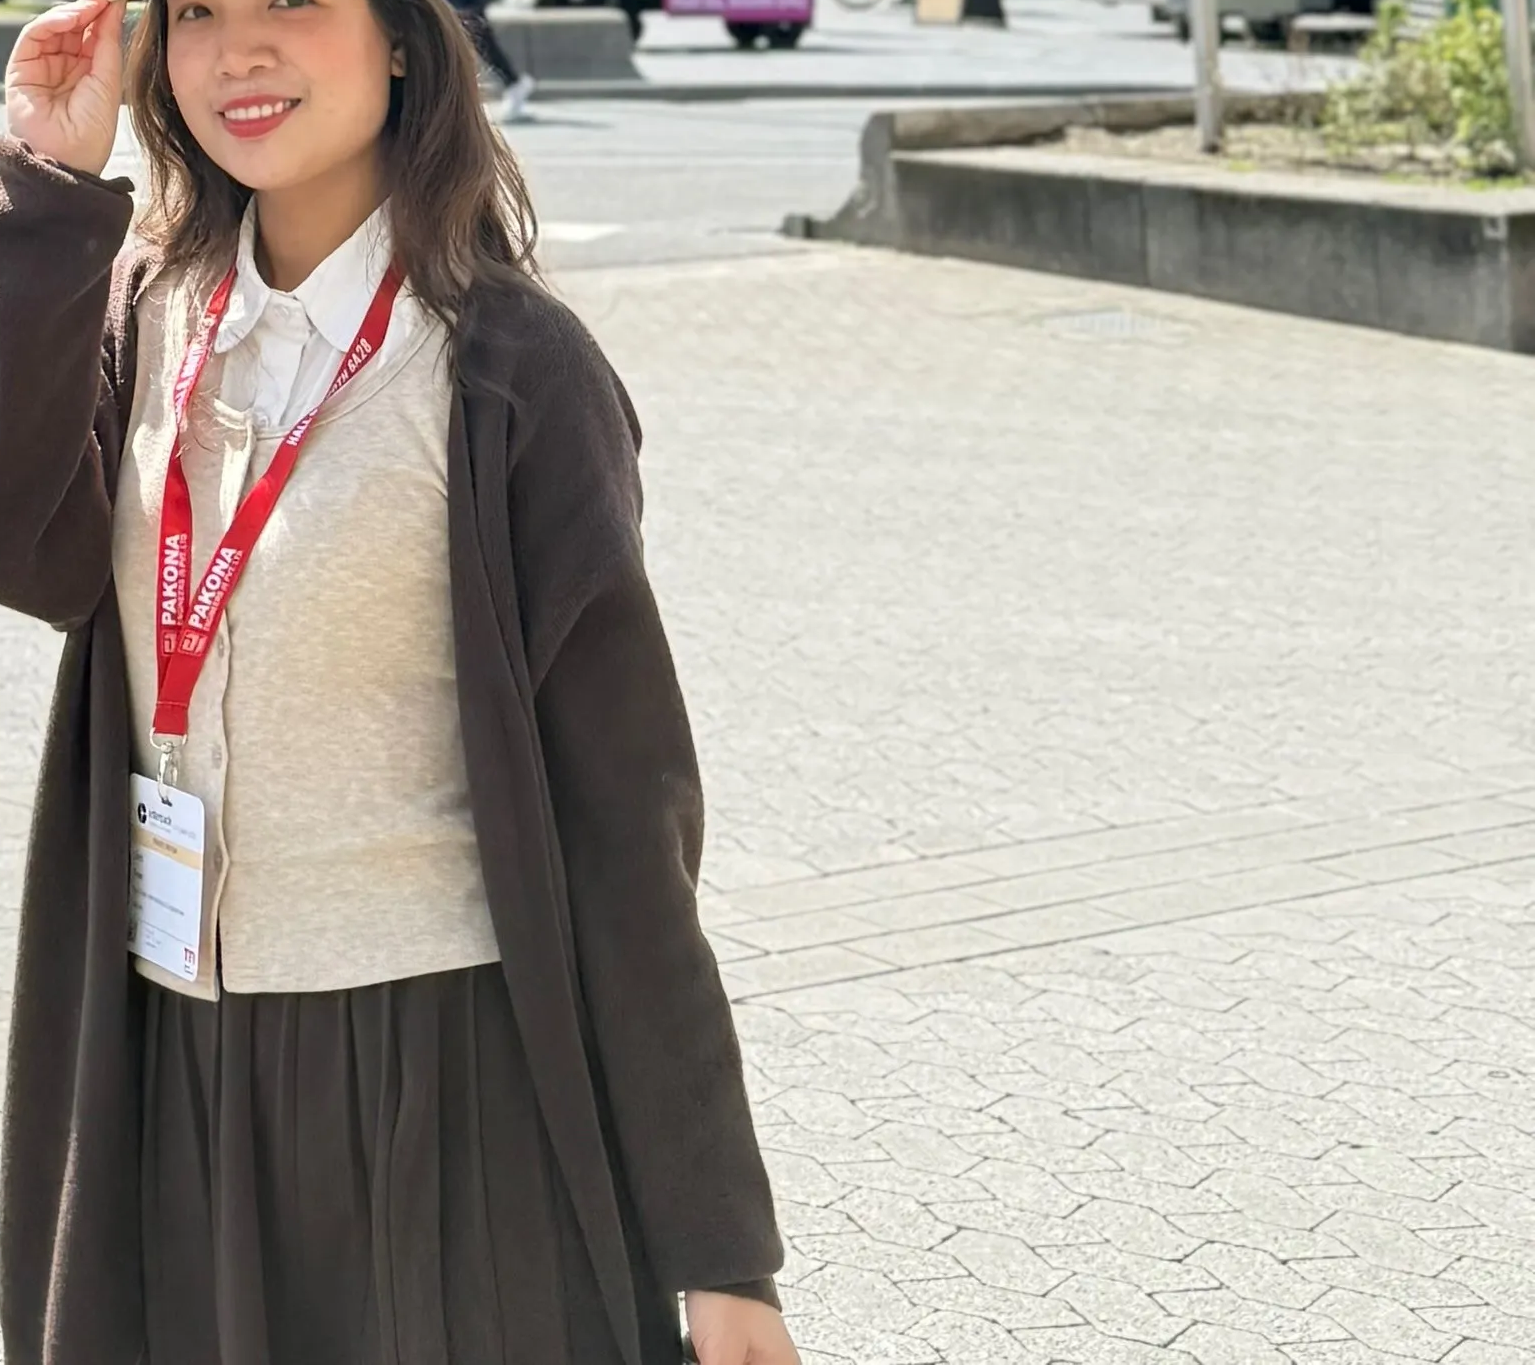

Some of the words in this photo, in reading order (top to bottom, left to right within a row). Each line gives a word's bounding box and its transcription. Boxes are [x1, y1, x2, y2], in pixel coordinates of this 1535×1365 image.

[347, 337, 373, 373] 6A28
[161, 534, 180, 626] PAKONA
[188, 547, 237, 629] PAKONA
